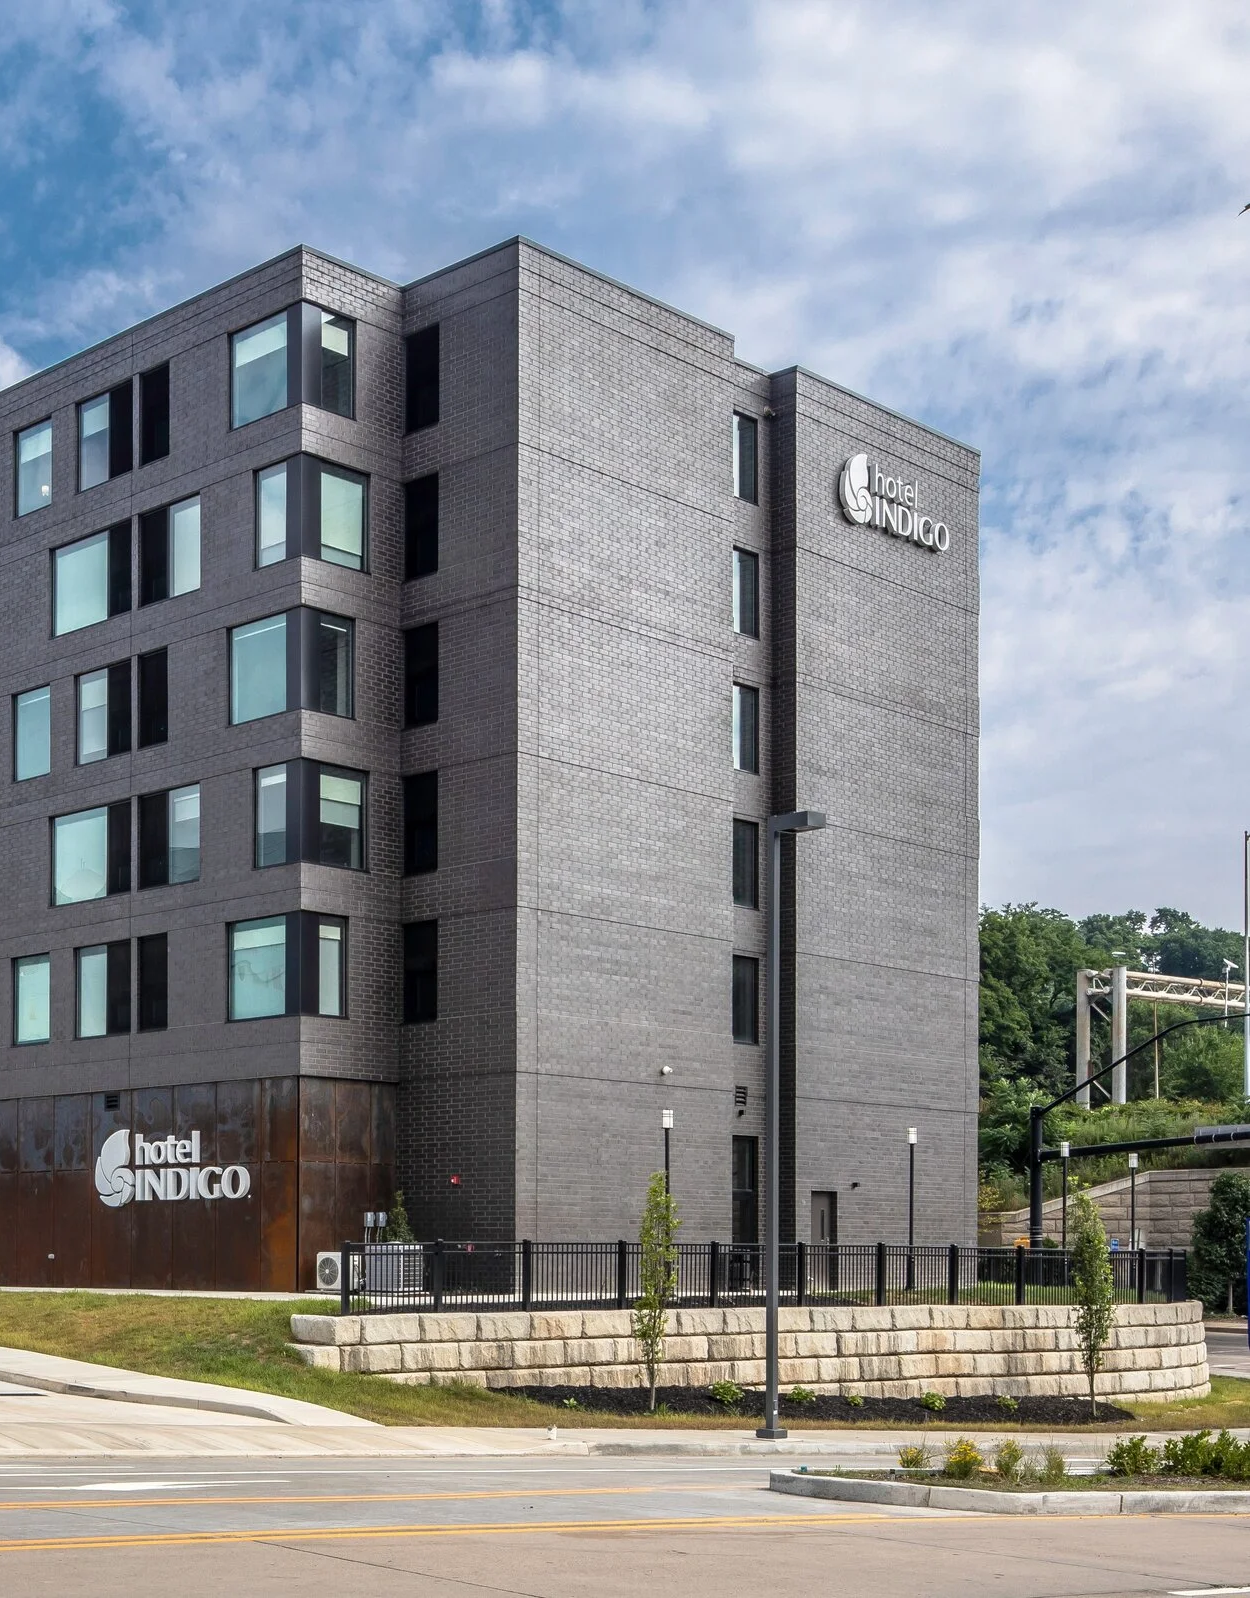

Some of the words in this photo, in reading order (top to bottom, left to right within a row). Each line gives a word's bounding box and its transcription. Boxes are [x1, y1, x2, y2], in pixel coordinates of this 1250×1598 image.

[872, 464, 919, 509] hotel
[873, 496, 950, 551] INDIGO
[135, 1130, 201, 1166] hotel
[135, 1166, 251, 1201] INDIGO
